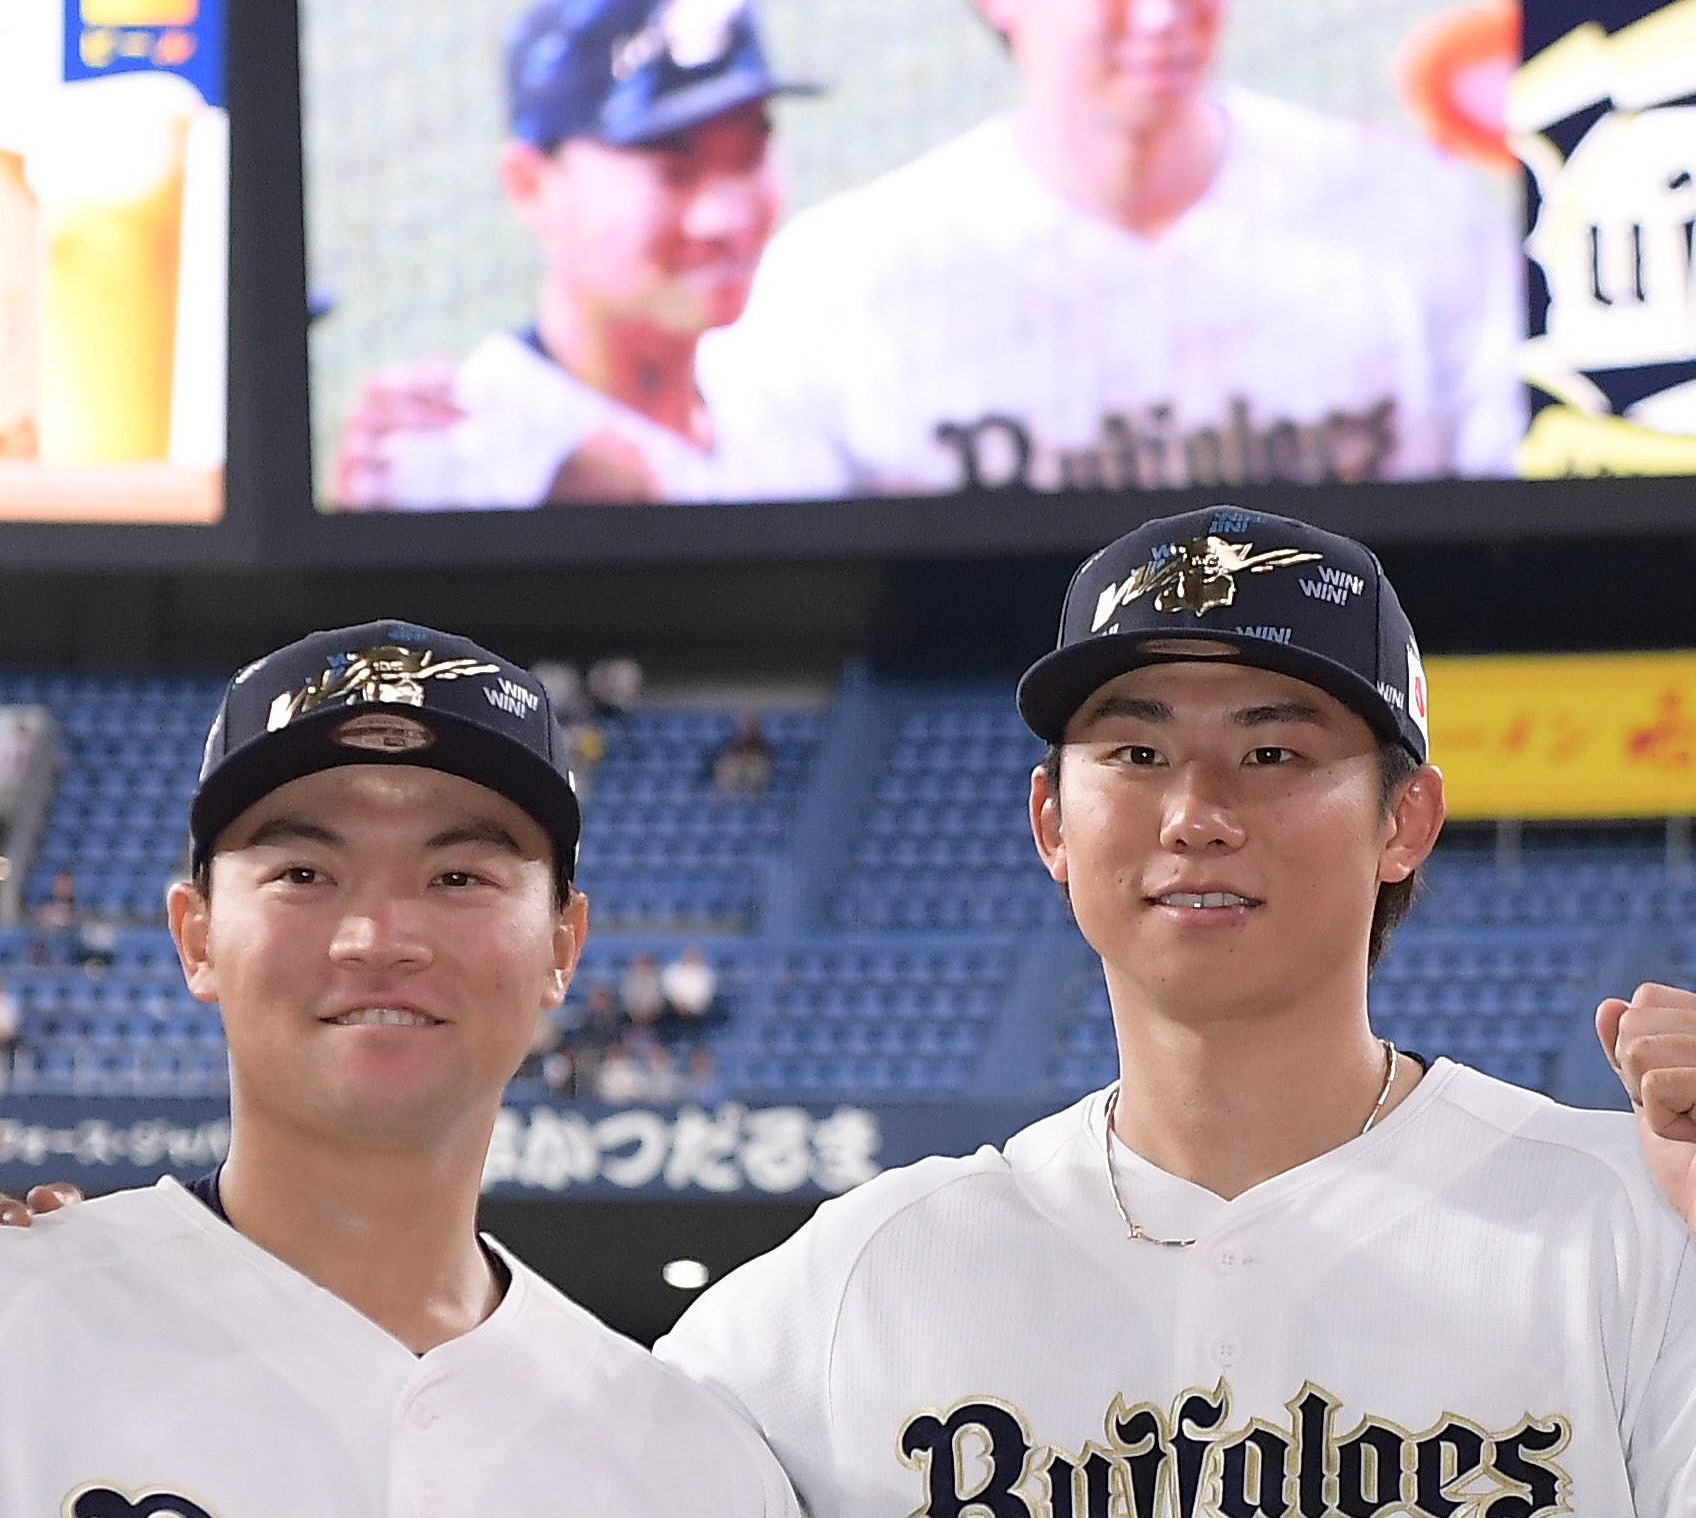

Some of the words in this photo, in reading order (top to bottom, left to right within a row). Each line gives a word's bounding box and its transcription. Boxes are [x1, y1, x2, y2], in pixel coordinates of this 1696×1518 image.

[1298, 578, 1349, 606] WIN!
[1317, 565, 1365, 597] WIN!
[482, 685, 527, 720] WIN!
[496, 676, 540, 712] WIN!
